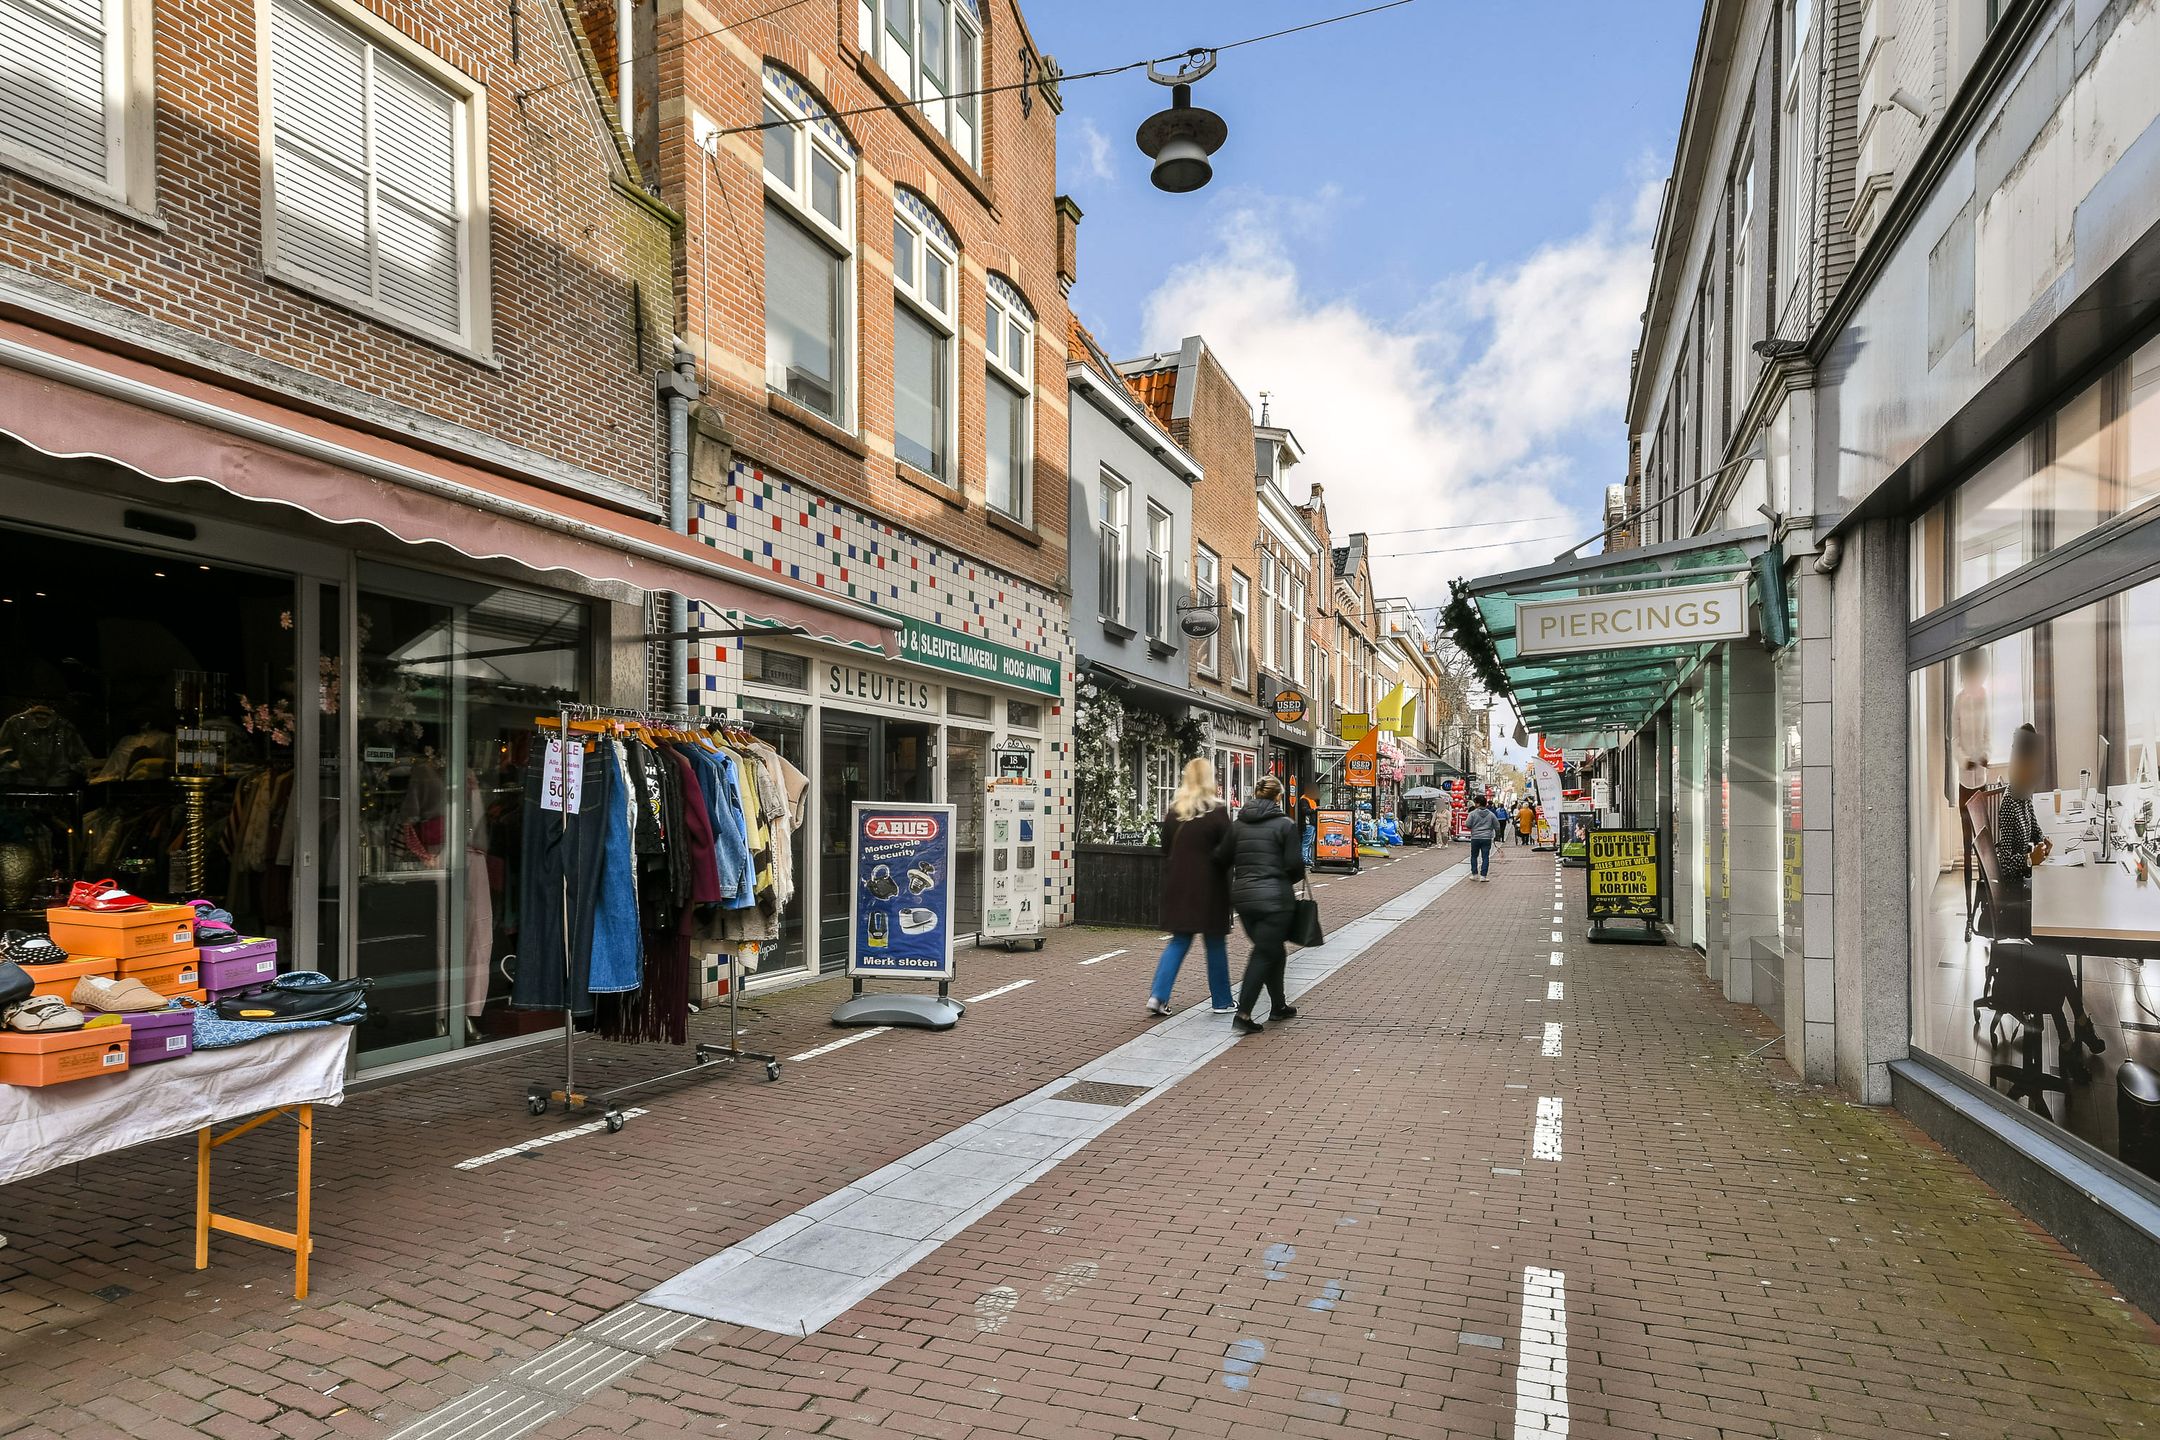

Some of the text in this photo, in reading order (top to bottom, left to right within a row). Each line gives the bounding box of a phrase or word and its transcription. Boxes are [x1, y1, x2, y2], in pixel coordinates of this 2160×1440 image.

[1540, 600, 1721, 640] PIERCINGS
[910, 630, 918, 651] &
[921, 632, 998, 672] SLEUTELMAKERIJ
[1003, 656, 1025, 679] HOOG
[1025, 663, 1052, 685] ANTINK
[830, 665, 928, 709] SLEUTELS
[1277, 701, 1301, 709] USED
[367, 751, 394, 759] GESLOTEN
[1010, 756, 1018, 764] 18
[875, 822, 929, 836] ABUS
[1593, 835, 1650, 843] SPORT FASHION
[864, 839, 921, 854] Motorcycle
[1593, 843, 1650, 858] OUTLET
[873, 848, 916, 861] Security
[1594, 861, 1613, 870] ALLES
[1614, 859, 1632, 867] MOET
[1599, 871, 1647, 882] TOT 80%
[996, 880, 1005, 888] 54
[1600, 883, 1648, 894] KORTING
[1020, 901, 1031, 911] 21
[863, 956, 938, 967] Merk sloten
